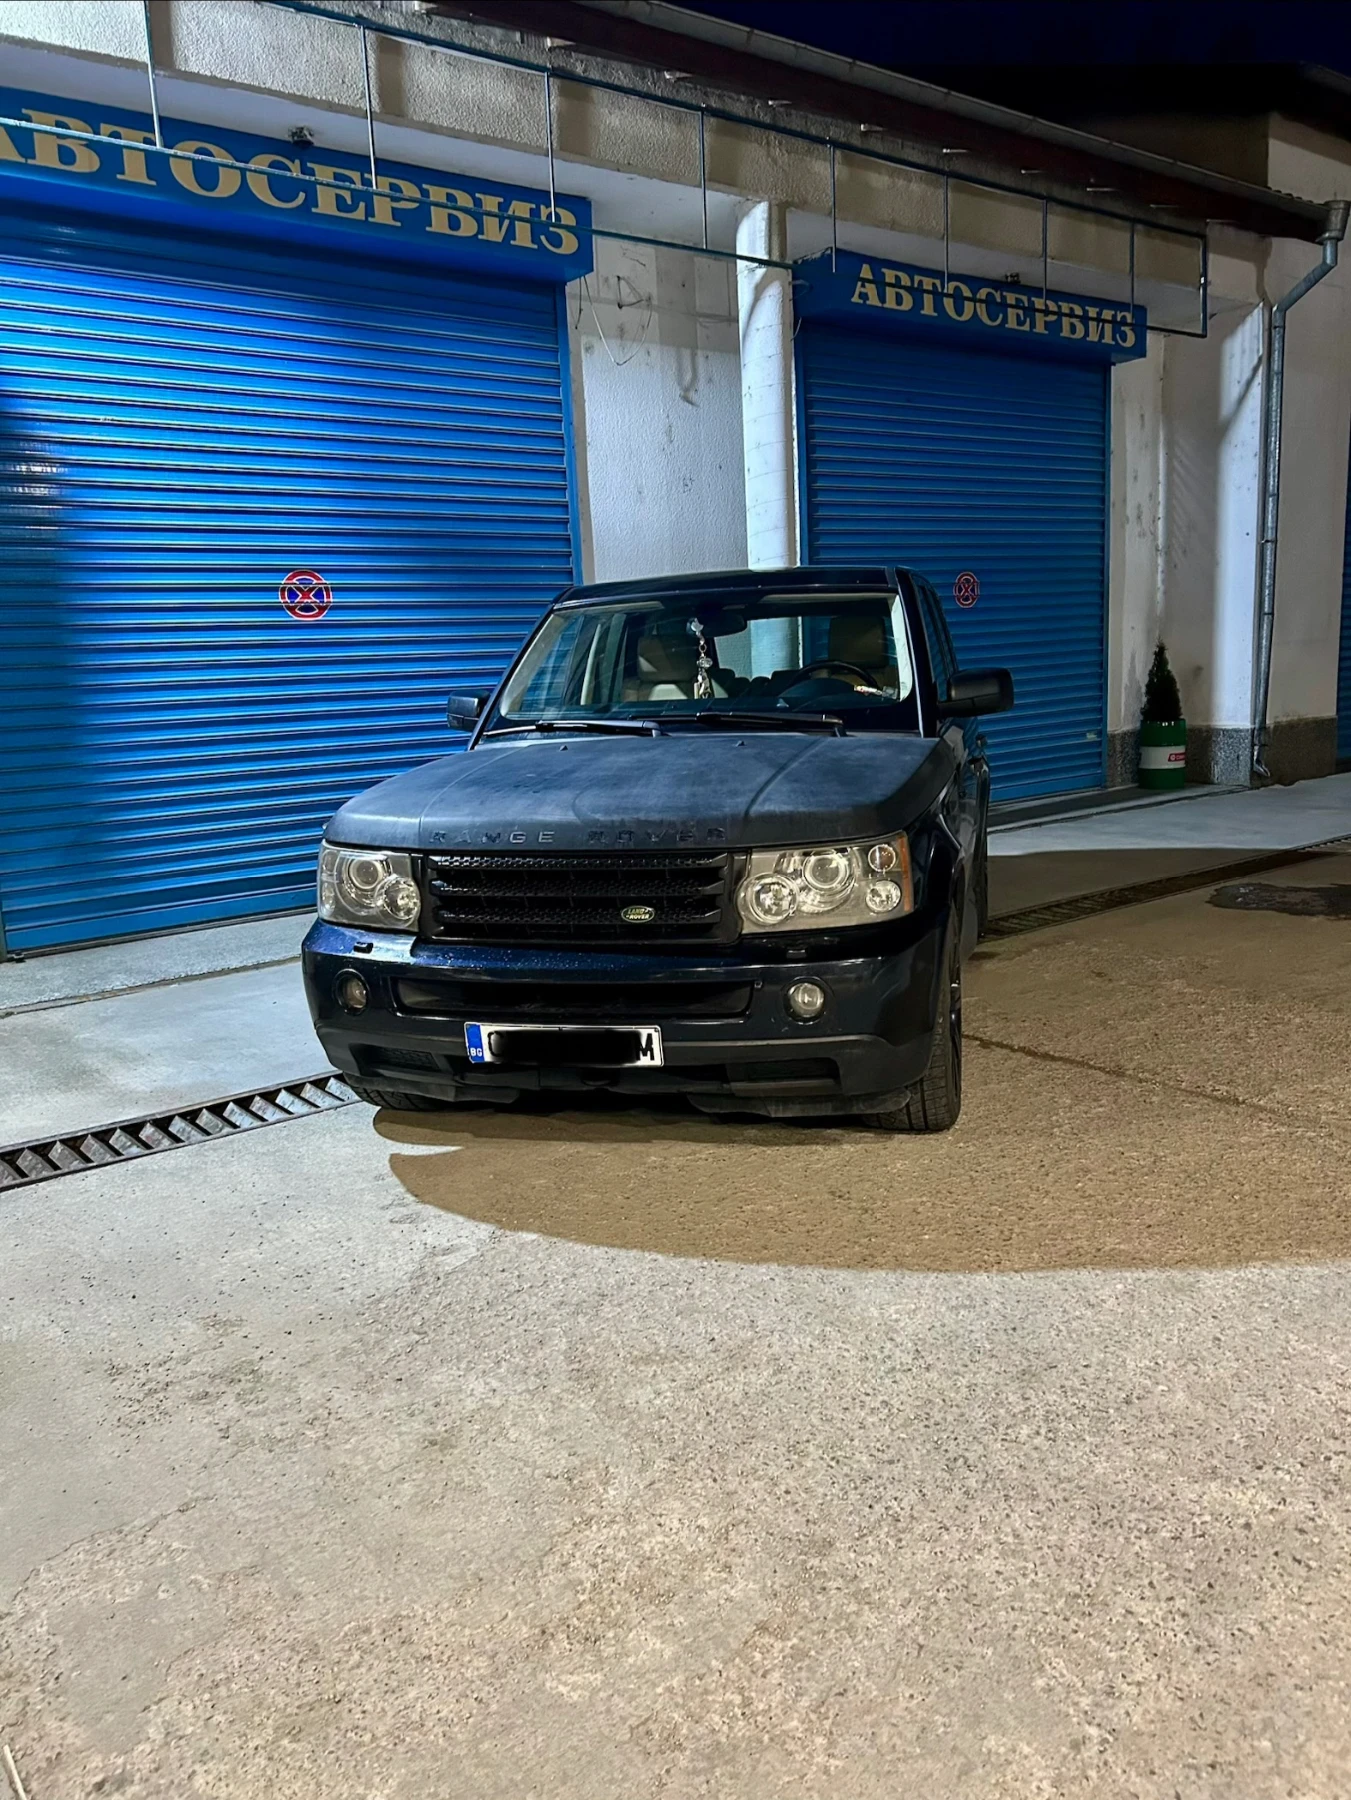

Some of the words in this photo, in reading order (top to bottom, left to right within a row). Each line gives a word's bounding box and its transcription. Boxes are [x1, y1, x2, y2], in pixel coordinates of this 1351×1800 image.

[851, 263, 1136, 348] АВТОСЕРВИЗ
[429, 830, 555, 844] RANGE
[470, 1047, 483, 1057] BG
